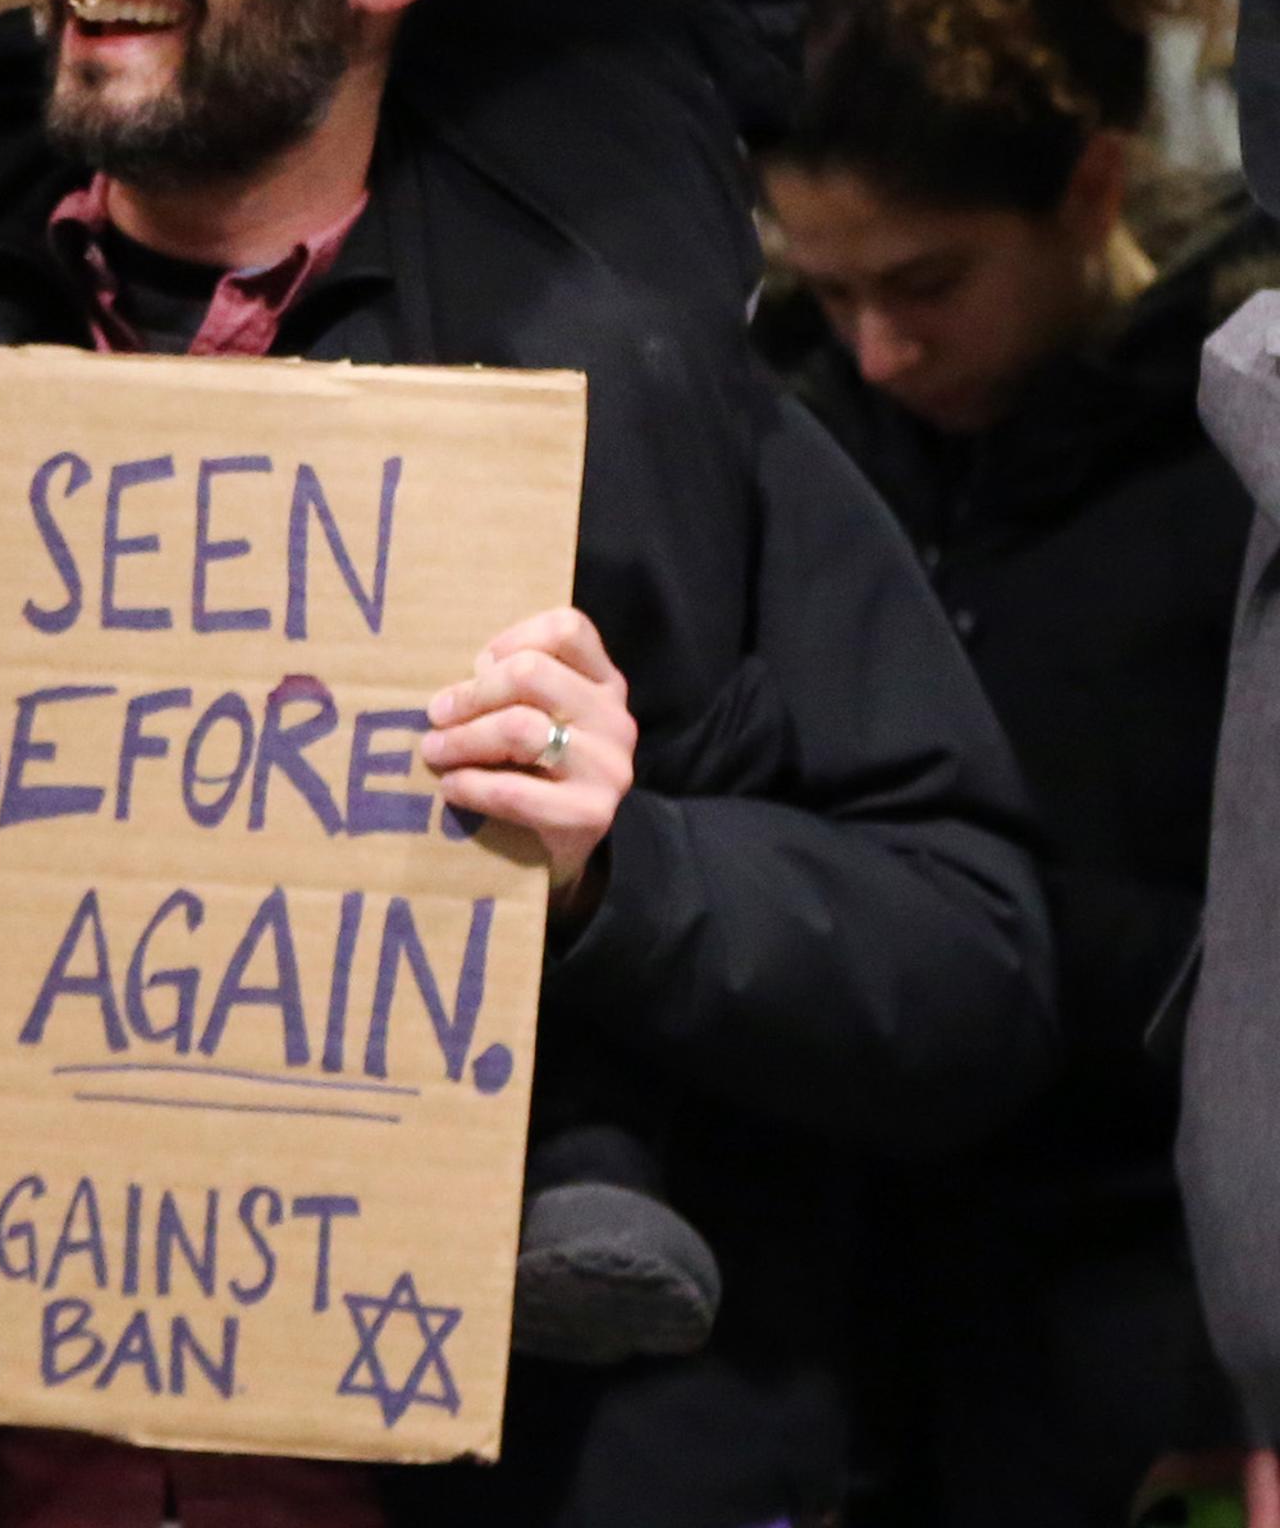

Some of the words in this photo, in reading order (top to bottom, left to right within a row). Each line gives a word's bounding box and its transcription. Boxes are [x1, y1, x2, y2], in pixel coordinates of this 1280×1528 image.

[20, 455, 404, 643] SEEN
[17, 885, 517, 1096] AGAIN.
[40, 1296, 241, 1400] BAN
